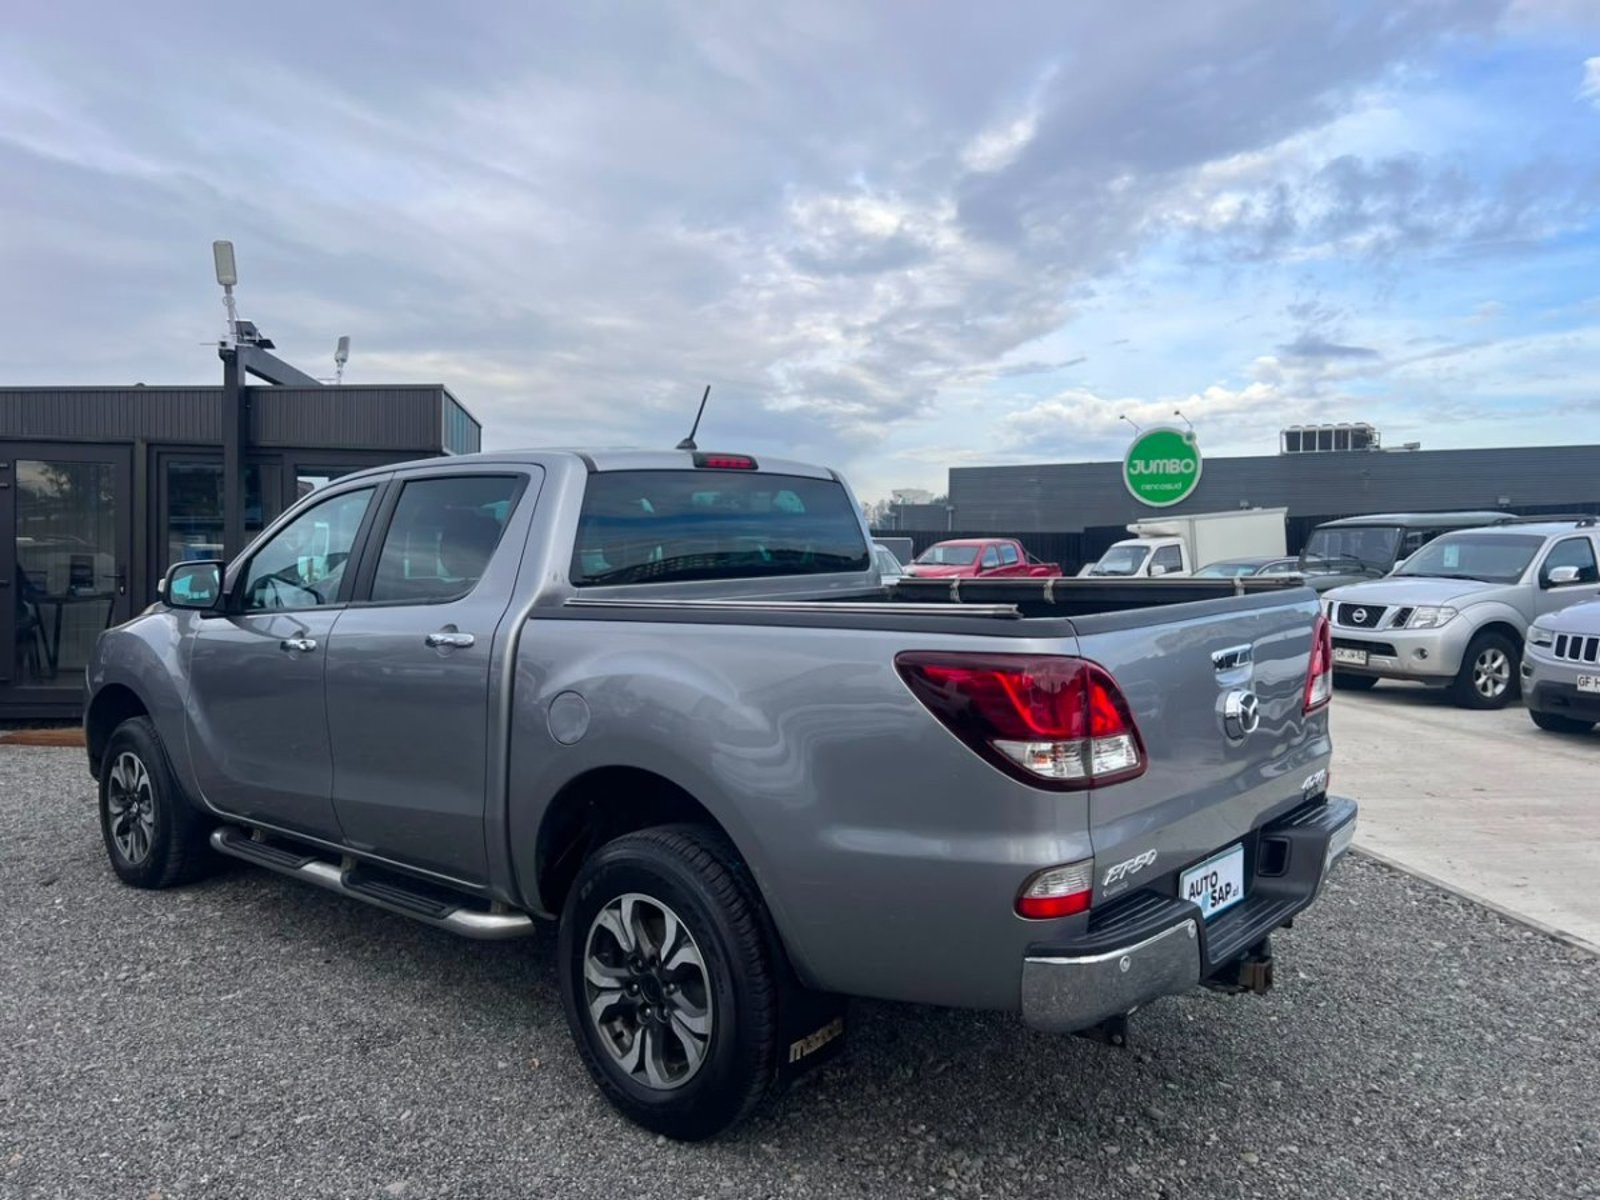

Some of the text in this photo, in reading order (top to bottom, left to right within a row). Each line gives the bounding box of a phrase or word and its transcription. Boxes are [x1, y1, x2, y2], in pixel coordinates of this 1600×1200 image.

[1129, 458, 1195, 475] JUMBO
[1141, 482, 1182, 491] cencosud
[1188, 871, 1218, 900] AUTO
